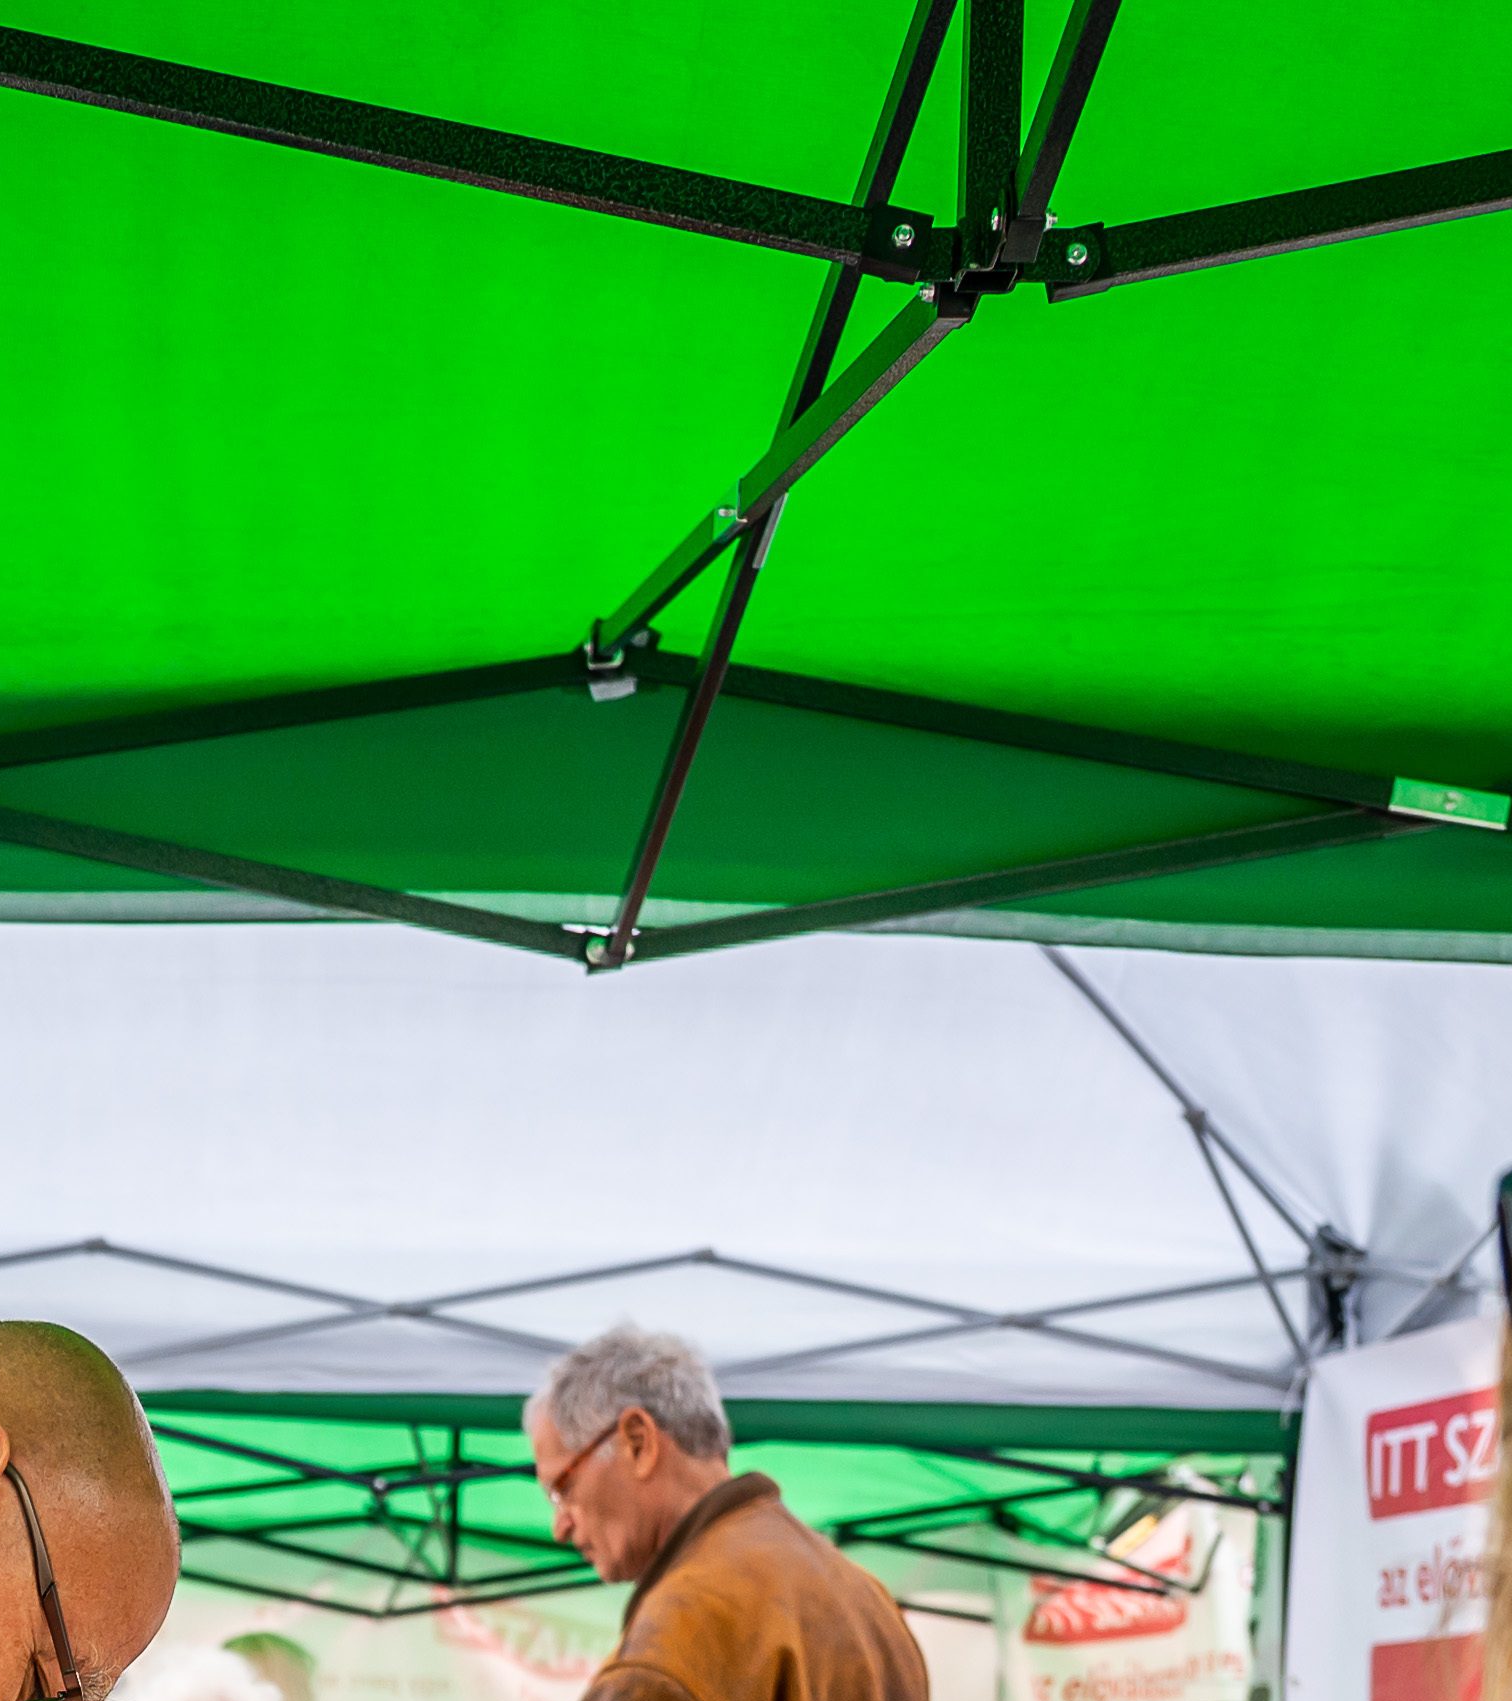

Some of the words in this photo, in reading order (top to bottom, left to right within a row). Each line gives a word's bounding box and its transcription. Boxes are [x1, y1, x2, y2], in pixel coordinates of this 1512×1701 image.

[1370, 1418, 1439, 1501] ITT
[1442, 1406, 1502, 1489] SZ
[1377, 1566, 1409, 1608] az
